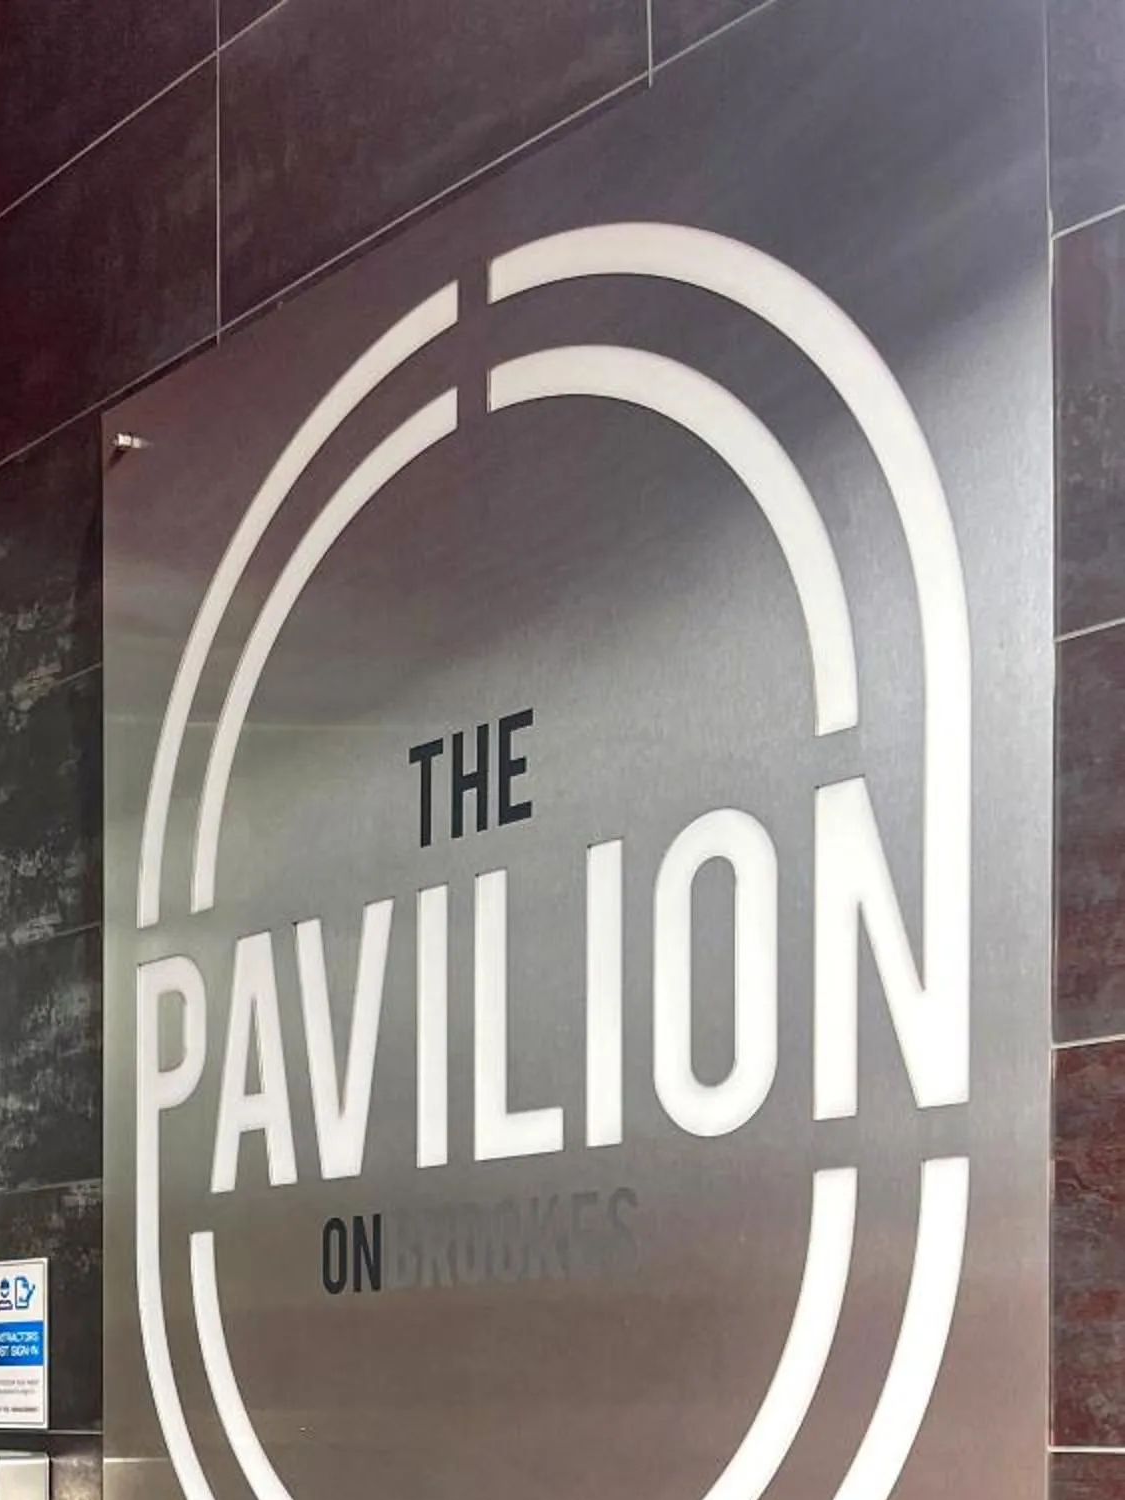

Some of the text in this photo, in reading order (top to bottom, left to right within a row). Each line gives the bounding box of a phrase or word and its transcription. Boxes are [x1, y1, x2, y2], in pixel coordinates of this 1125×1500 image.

[409, 708, 534, 848] THE
[136, 776, 971, 1194] PAVILION
[321, 1213, 382, 1295] ON
[11, 1345, 30, 1357] SIGN
